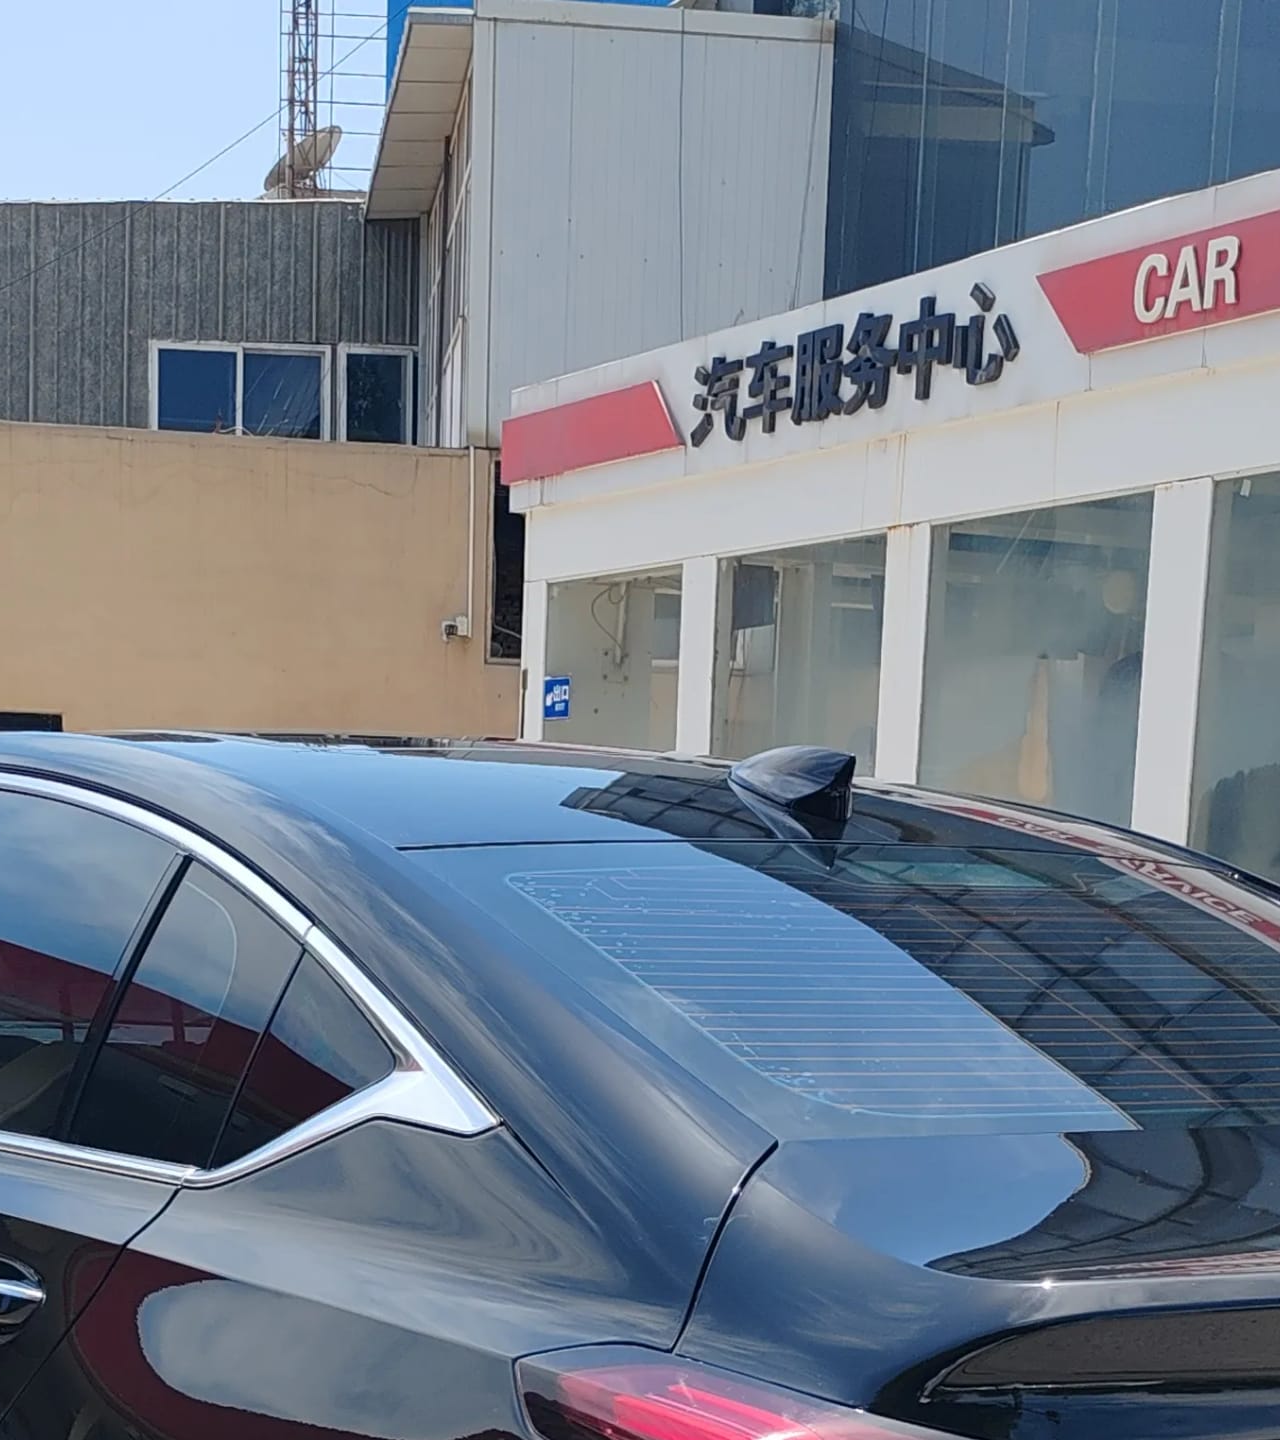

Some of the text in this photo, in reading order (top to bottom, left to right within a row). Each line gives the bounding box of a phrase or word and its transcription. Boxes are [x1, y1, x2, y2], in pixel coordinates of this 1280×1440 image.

[1134, 235, 1240, 323] CAR
[690, 282, 1020, 448] 汽车服务中心
